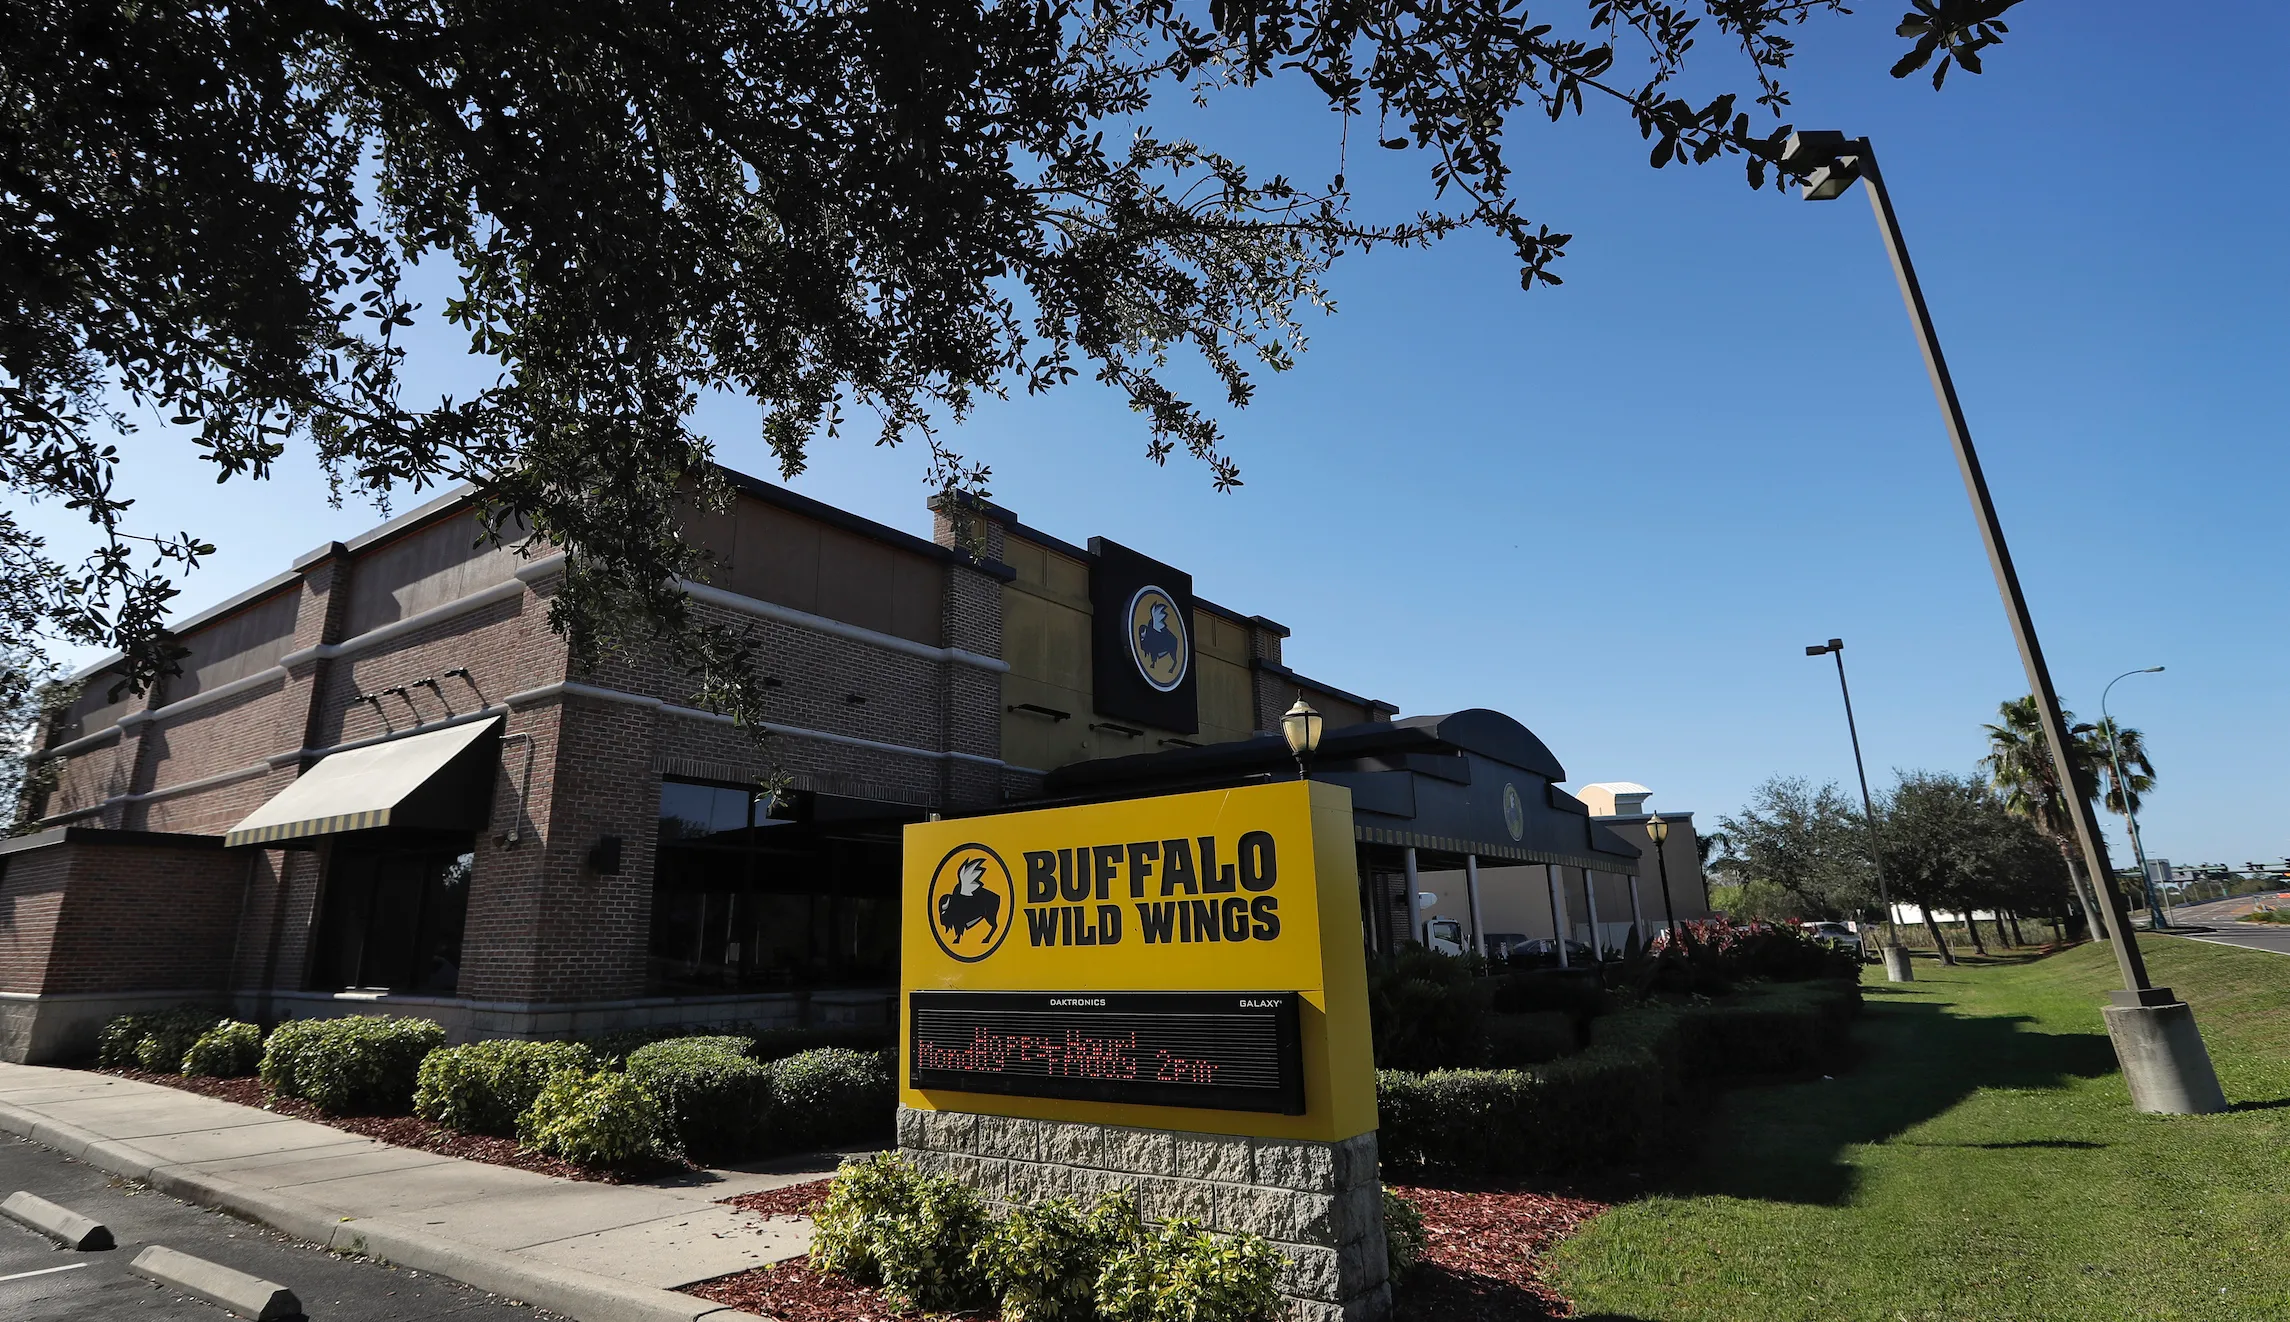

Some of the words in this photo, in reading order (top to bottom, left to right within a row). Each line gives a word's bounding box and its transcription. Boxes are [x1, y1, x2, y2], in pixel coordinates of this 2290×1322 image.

[1022, 830, 1278, 904] BUFFALO
[1023, 904, 1123, 947] WILD
[1135, 895, 1281, 945] WINGS
